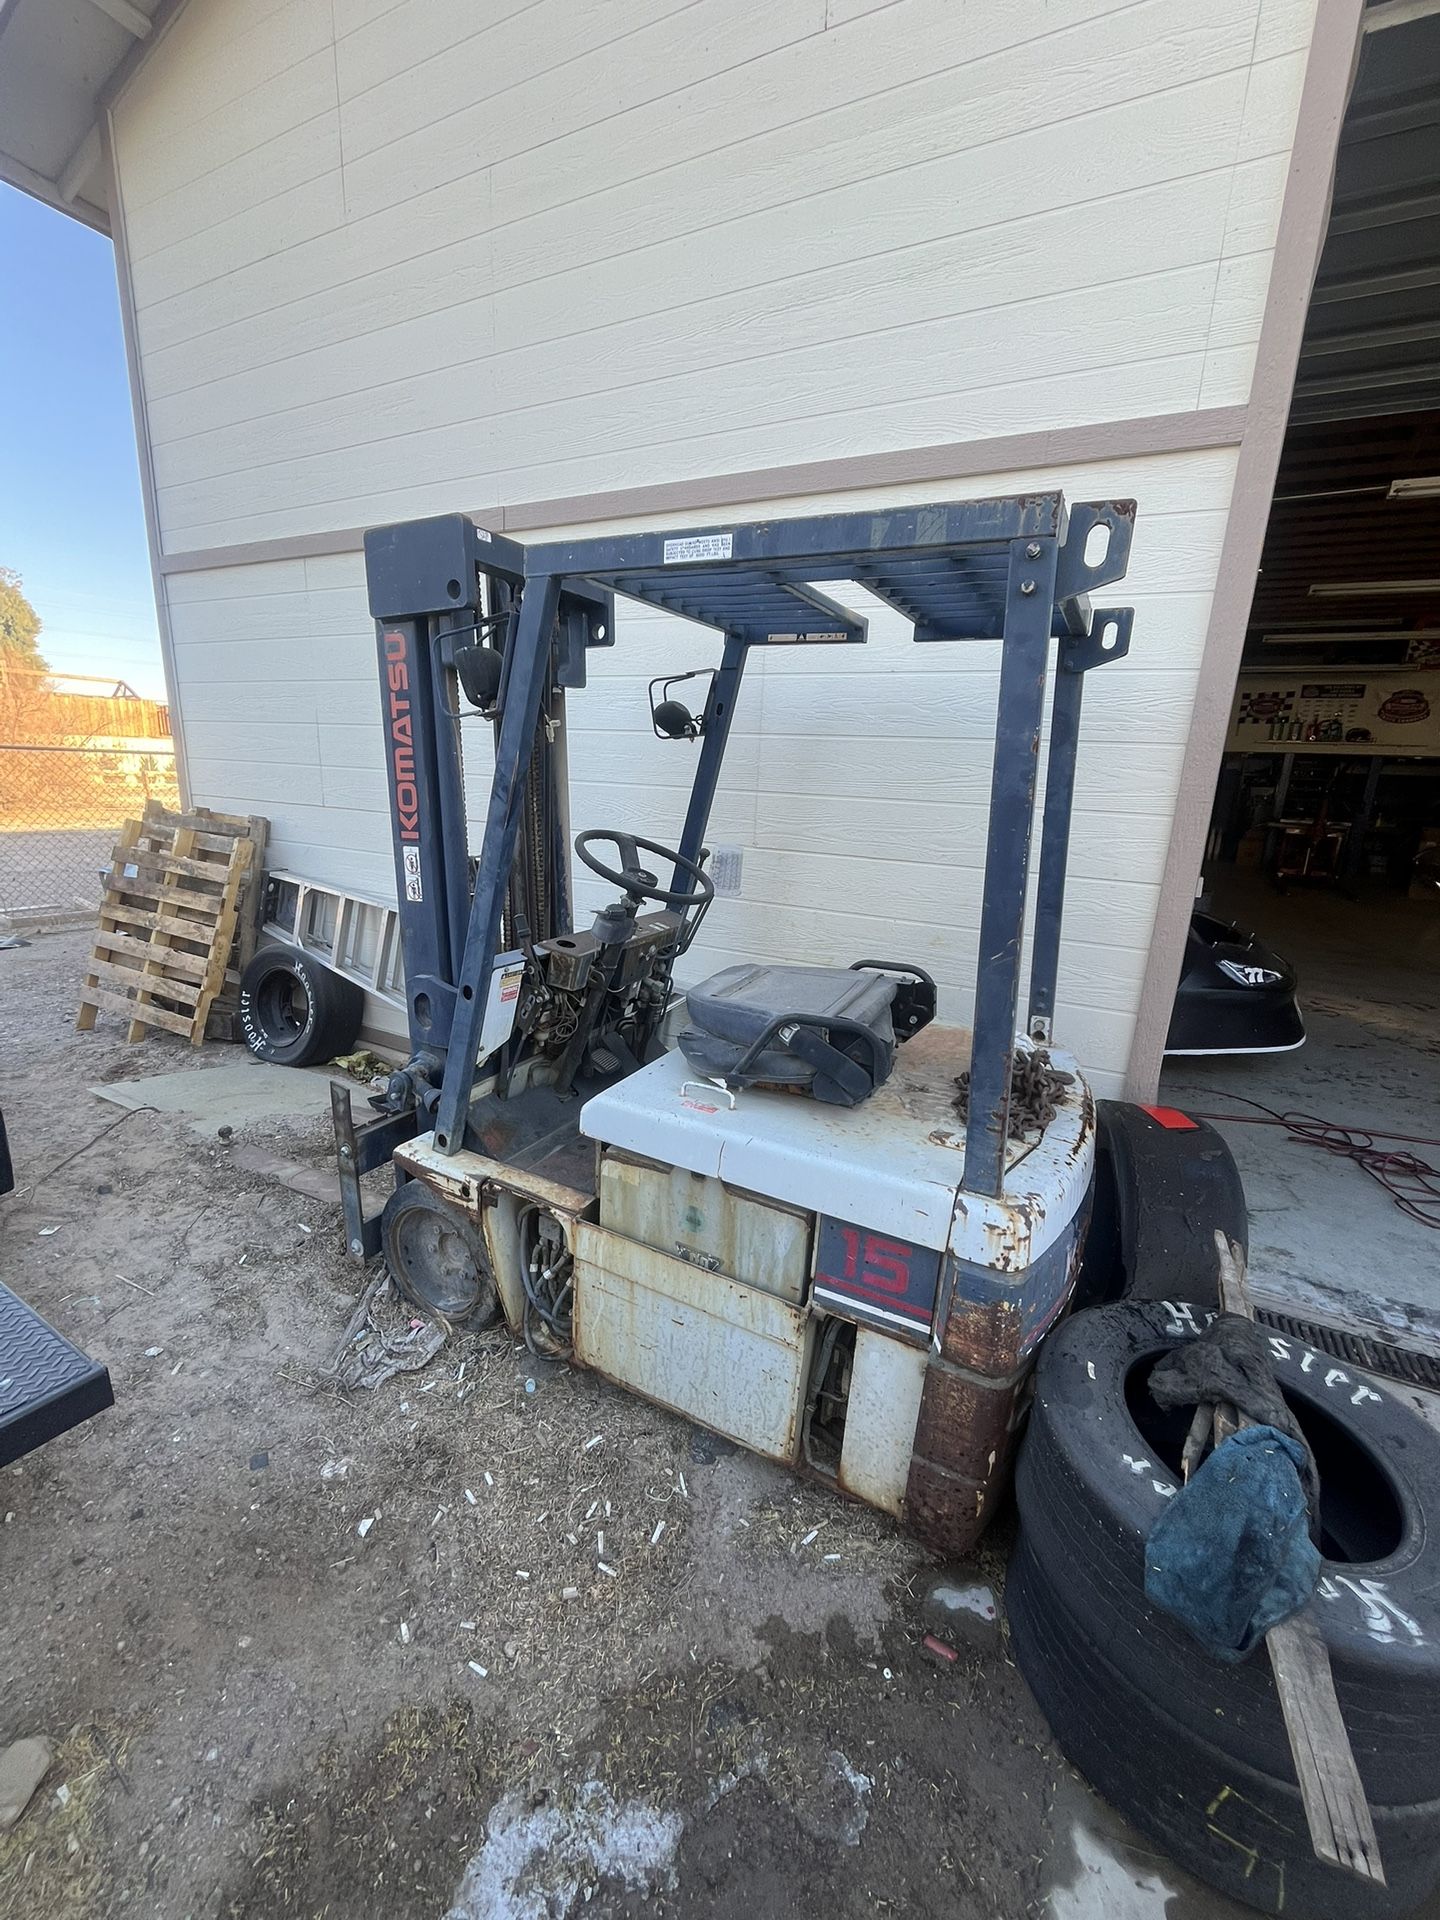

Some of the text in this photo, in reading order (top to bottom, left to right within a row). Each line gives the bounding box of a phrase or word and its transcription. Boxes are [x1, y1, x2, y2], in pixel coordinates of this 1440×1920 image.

[384, 632, 420, 840] KOMATSU
[1243, 967, 1264, 983] 77
[241, 990, 266, 1053] Hoosier
[841, 1227, 912, 1295] 15
[1161, 1300, 1382, 1406] Hsier
